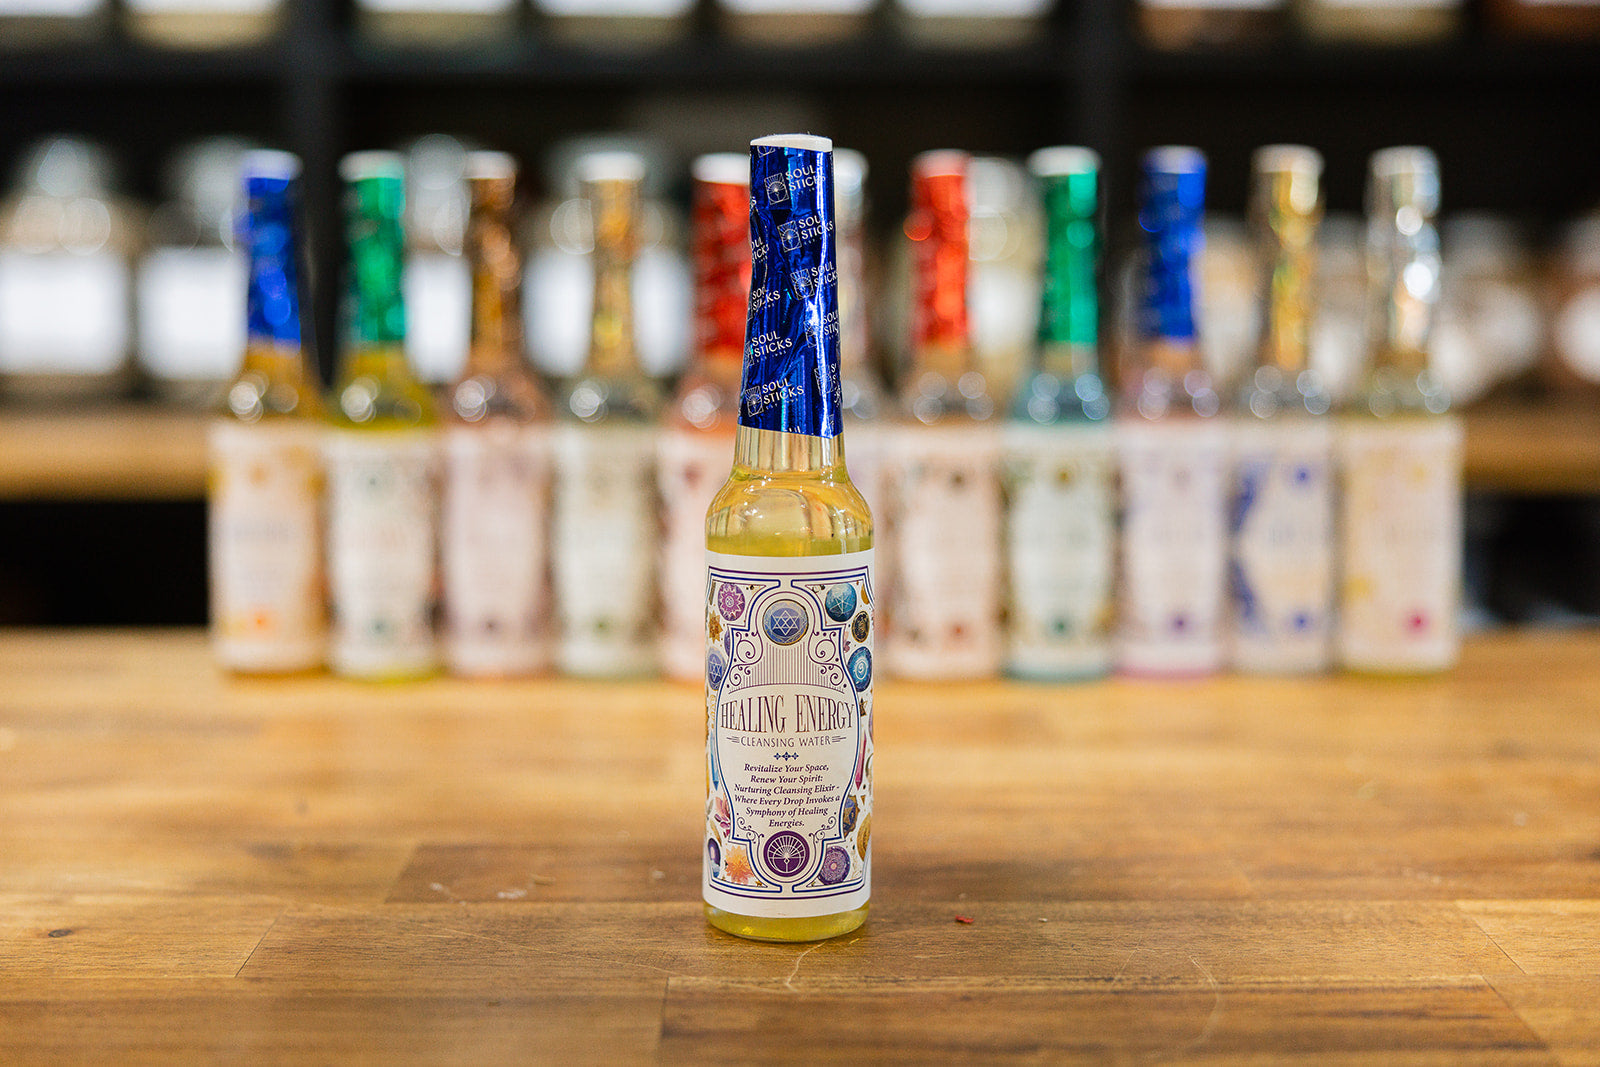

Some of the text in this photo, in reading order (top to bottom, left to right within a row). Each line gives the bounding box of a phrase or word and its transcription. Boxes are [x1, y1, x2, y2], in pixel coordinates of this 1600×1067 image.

[786, 164, 816, 180] SOUL
[798, 215, 822, 228] SOU
[814, 270, 838, 287] SICK
[752, 330, 780, 346] SOUL
[754, 338, 792, 358] STICKS
[762, 378, 792, 394] SOUL
[764, 385, 804, 404] STICKS
[720, 694, 854, 733] HEALING ENERGY
[740, 736, 830, 748] CLEANSING WATER
[744, 763, 829, 774] Revitalize Your Space,
[750, 774, 776, 783] Renew
[734, 784, 772, 796] Nurturing
[774, 786, 812, 796] Cleansing
[814, 784, 835, 793] Elixir
[734, 794, 758, 804] Where
[760, 798, 782, 807] Every
[784, 797, 804, 806] Drop
[806, 795, 834, 804] Invokes
[746, 806, 828, 818] Symphony of Healing
[768, 819, 804, 829] Energies.
